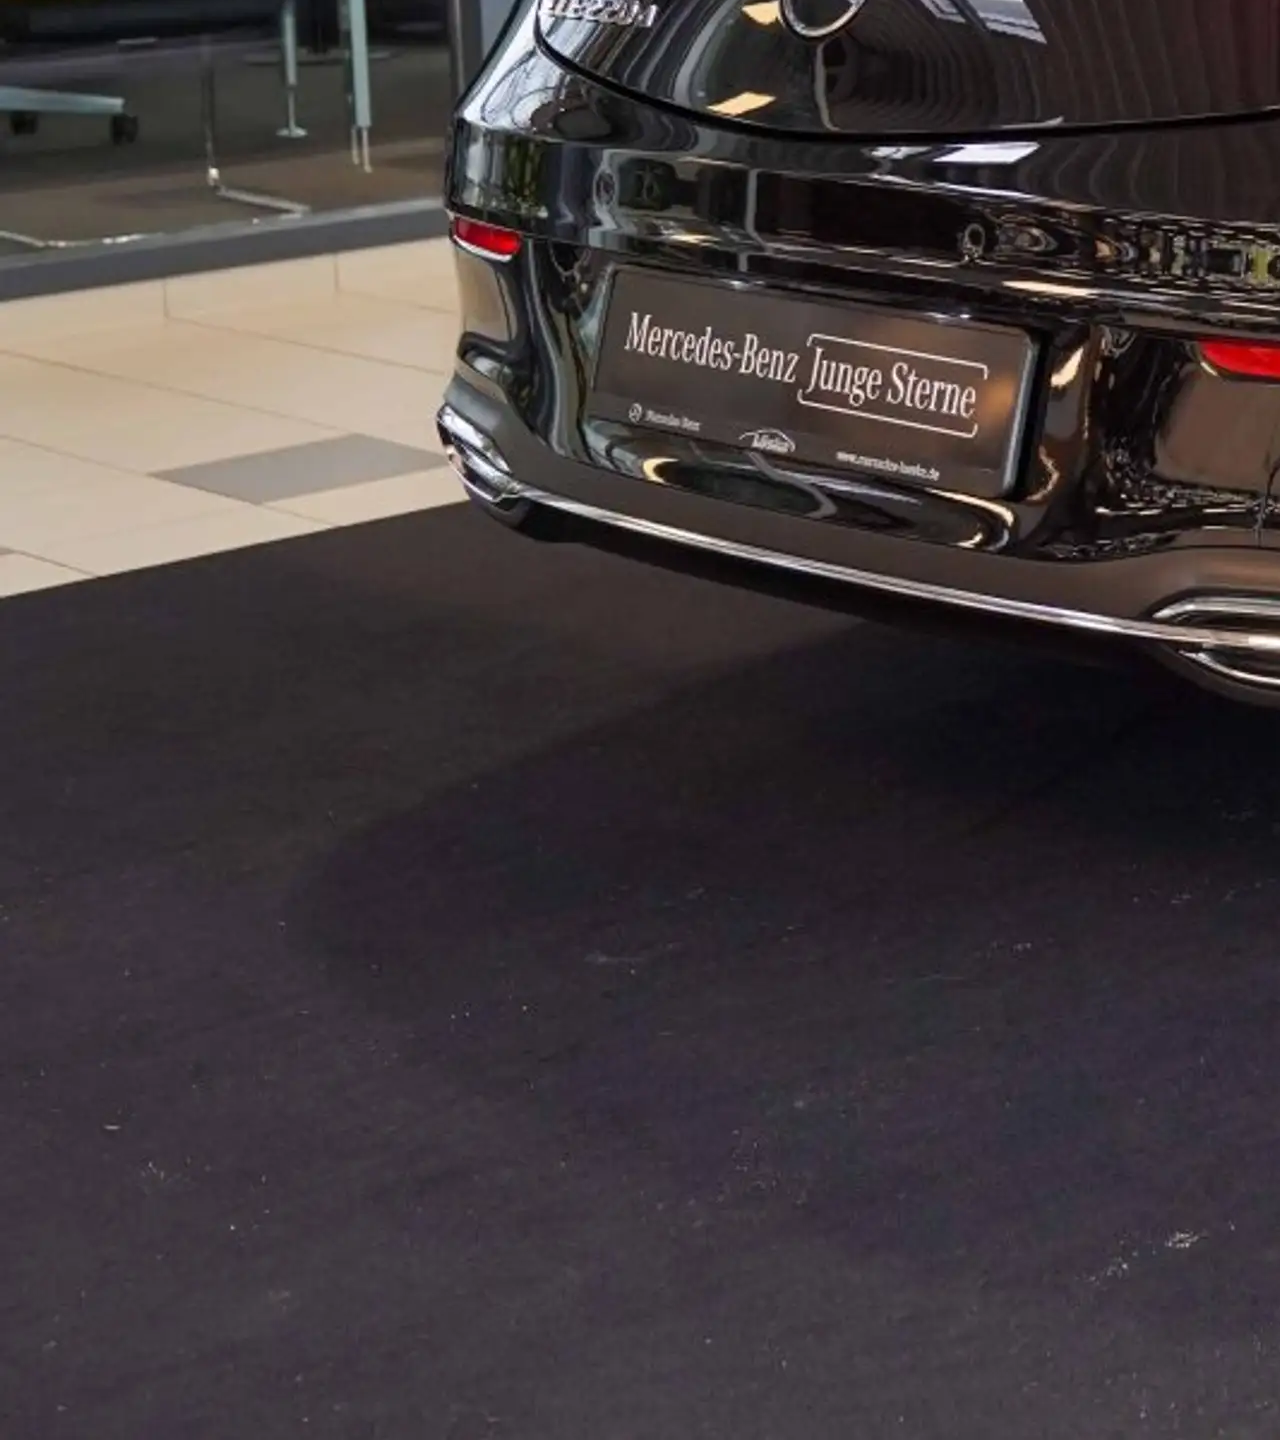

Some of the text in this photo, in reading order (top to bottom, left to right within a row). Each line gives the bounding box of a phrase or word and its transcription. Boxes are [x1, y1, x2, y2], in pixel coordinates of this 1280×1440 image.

[624, 311, 977, 419] Mercedes-Benz Junge Sterne
